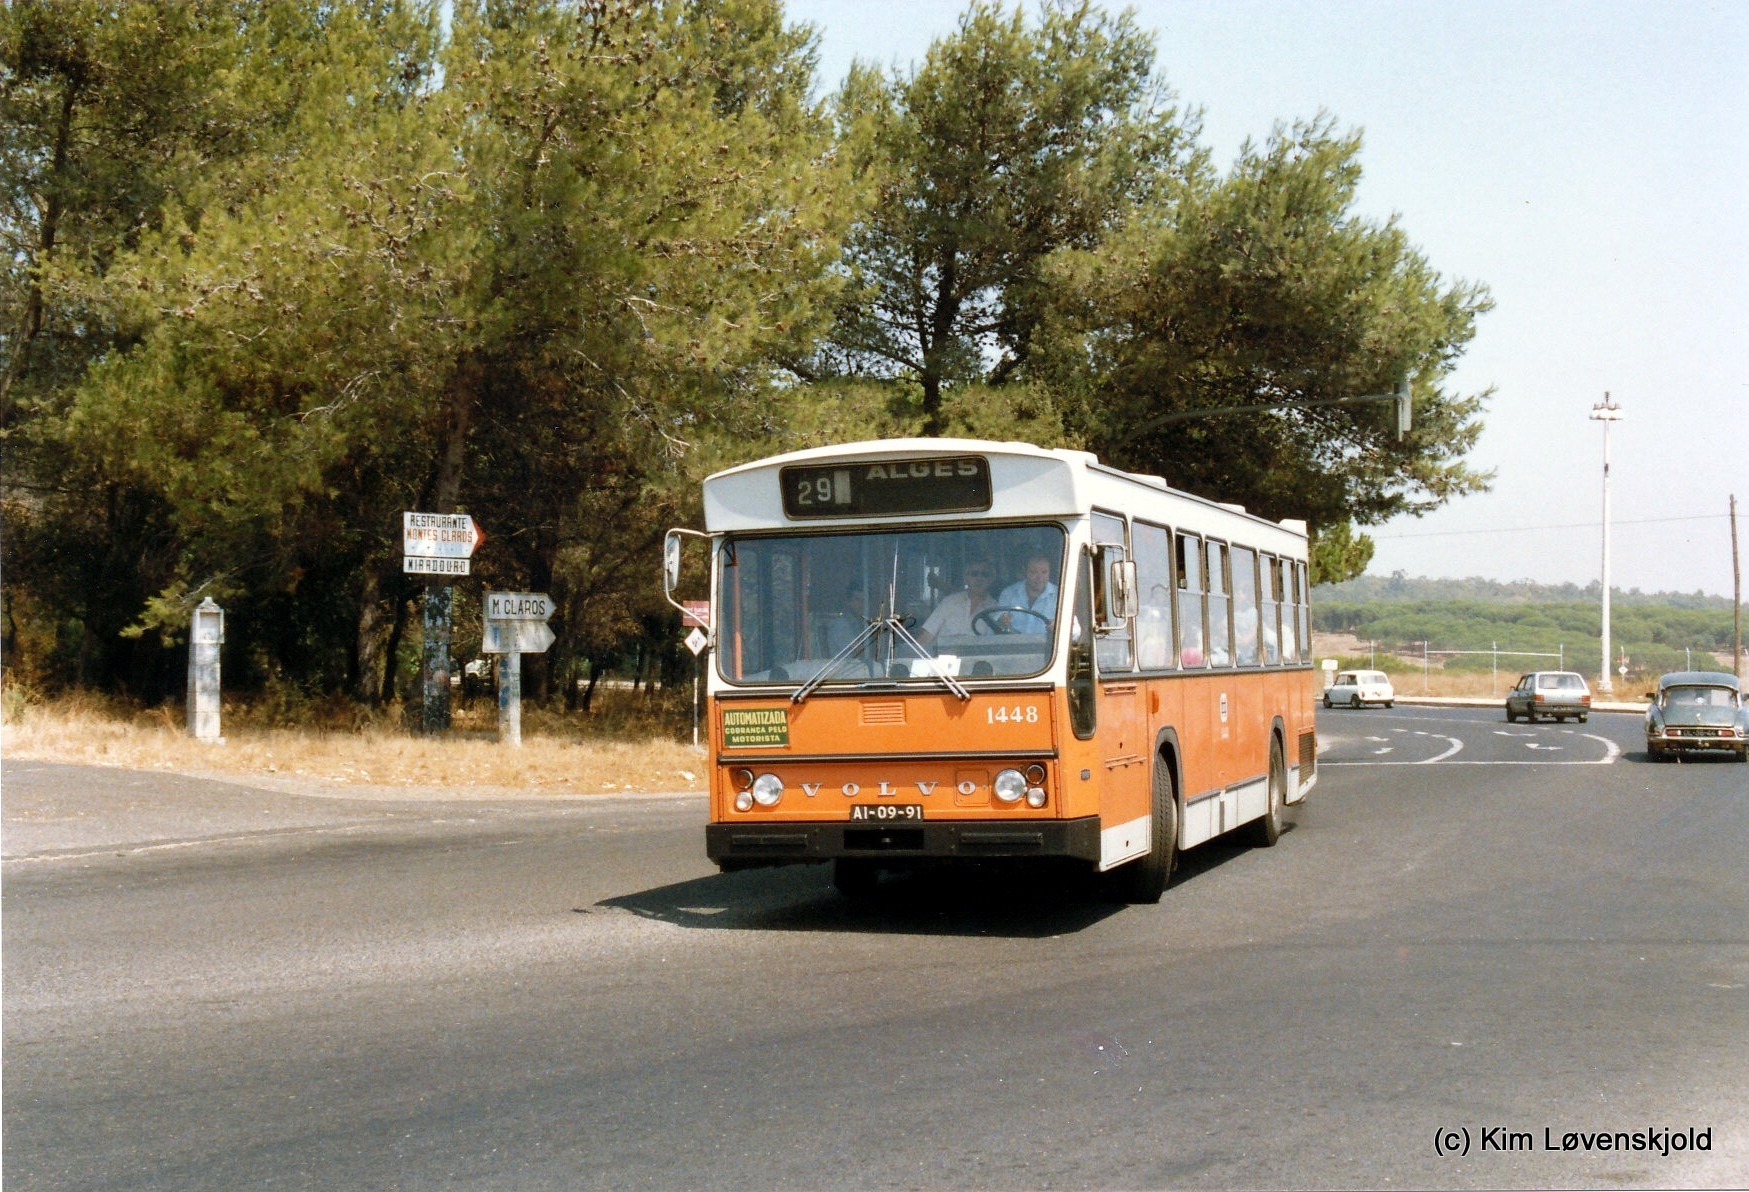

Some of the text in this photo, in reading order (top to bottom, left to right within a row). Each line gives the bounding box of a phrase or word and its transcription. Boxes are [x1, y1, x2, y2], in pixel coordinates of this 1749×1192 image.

[797, 477, 831, 505] 29
[410, 514, 467, 529] RESTAURANTE
[441, 530, 473, 543] CLAROS
[408, 559, 466, 573] MIRADOURO
[504, 599, 545, 615] CLAROS
[725, 711, 786, 725] AUTOMATIZADA
[987, 706, 1039, 724] 1448
[725, 725, 787, 735] COBRANÇA PELO
[732, 735, 780, 743] MOTORISTA
[800, 780, 976, 797] VOLVO
[853, 806, 922, 820] AI-09-91
